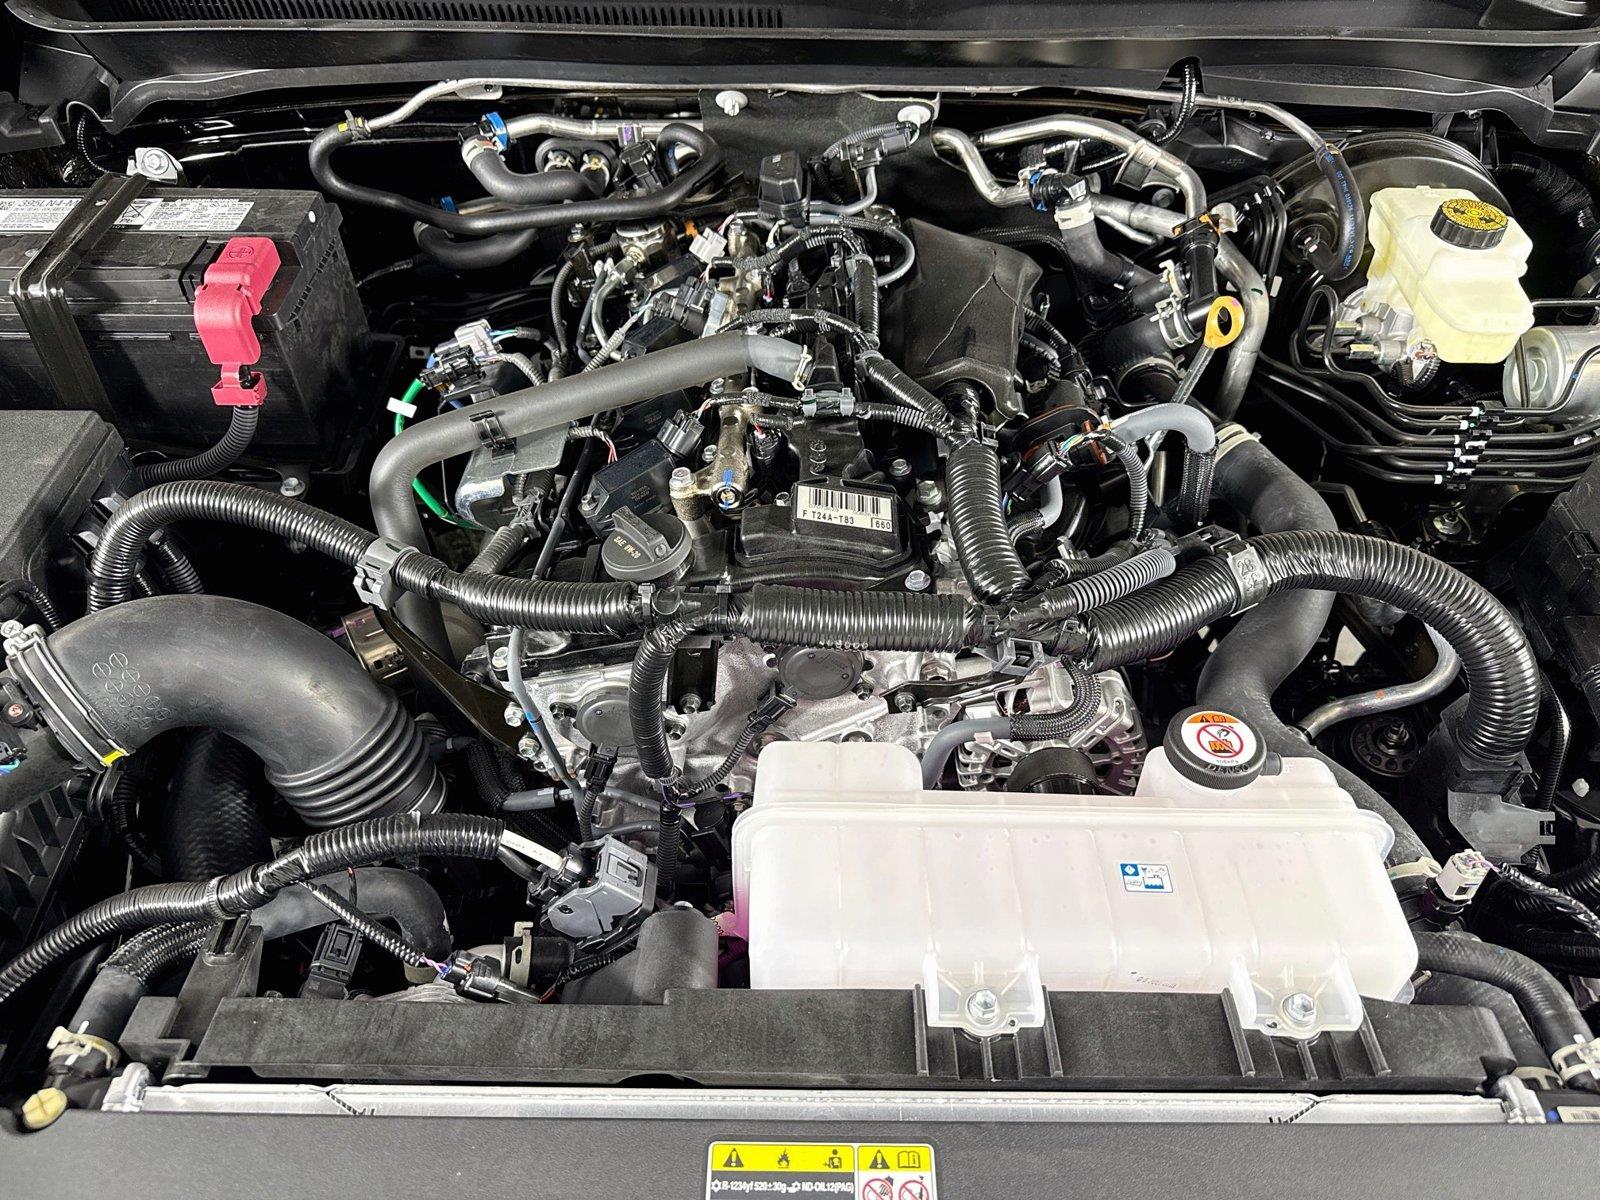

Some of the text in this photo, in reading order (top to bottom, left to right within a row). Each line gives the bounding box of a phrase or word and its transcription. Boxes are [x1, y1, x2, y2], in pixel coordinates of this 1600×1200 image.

[802, 509, 808, 518] F
[811, 510, 855, 525] T24A-T83
[613, 536, 627, 547] SAE
[1205, 763, 1250, 774] DENSO
